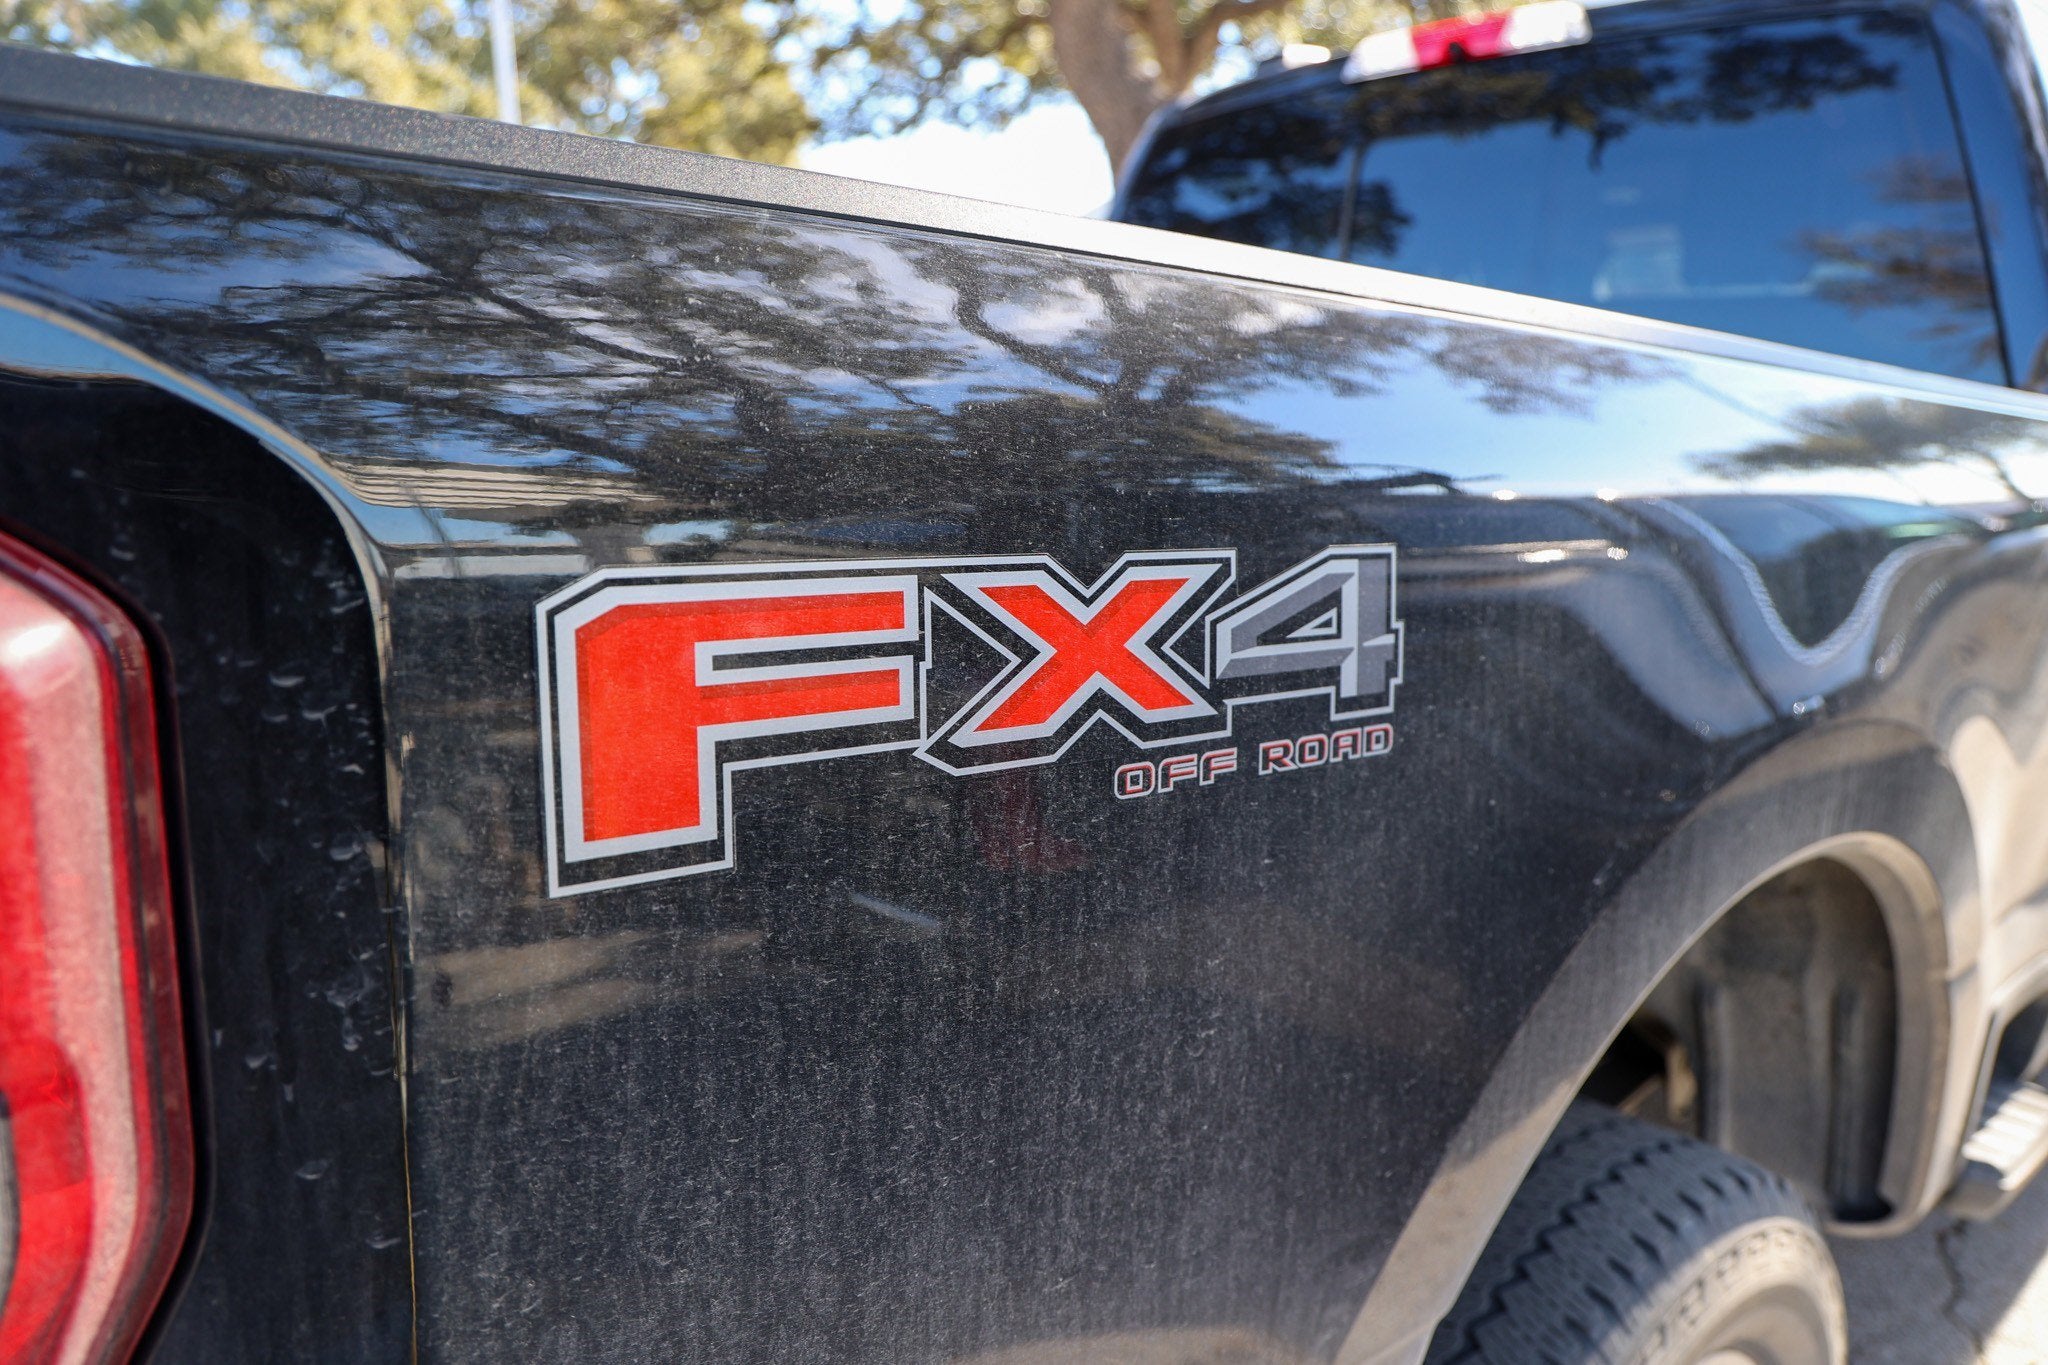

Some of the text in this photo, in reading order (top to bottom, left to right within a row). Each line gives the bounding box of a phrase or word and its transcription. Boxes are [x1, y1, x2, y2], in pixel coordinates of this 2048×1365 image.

[537, 544, 1403, 897] FX4
[1114, 723, 1393, 799] OFF ROAD
